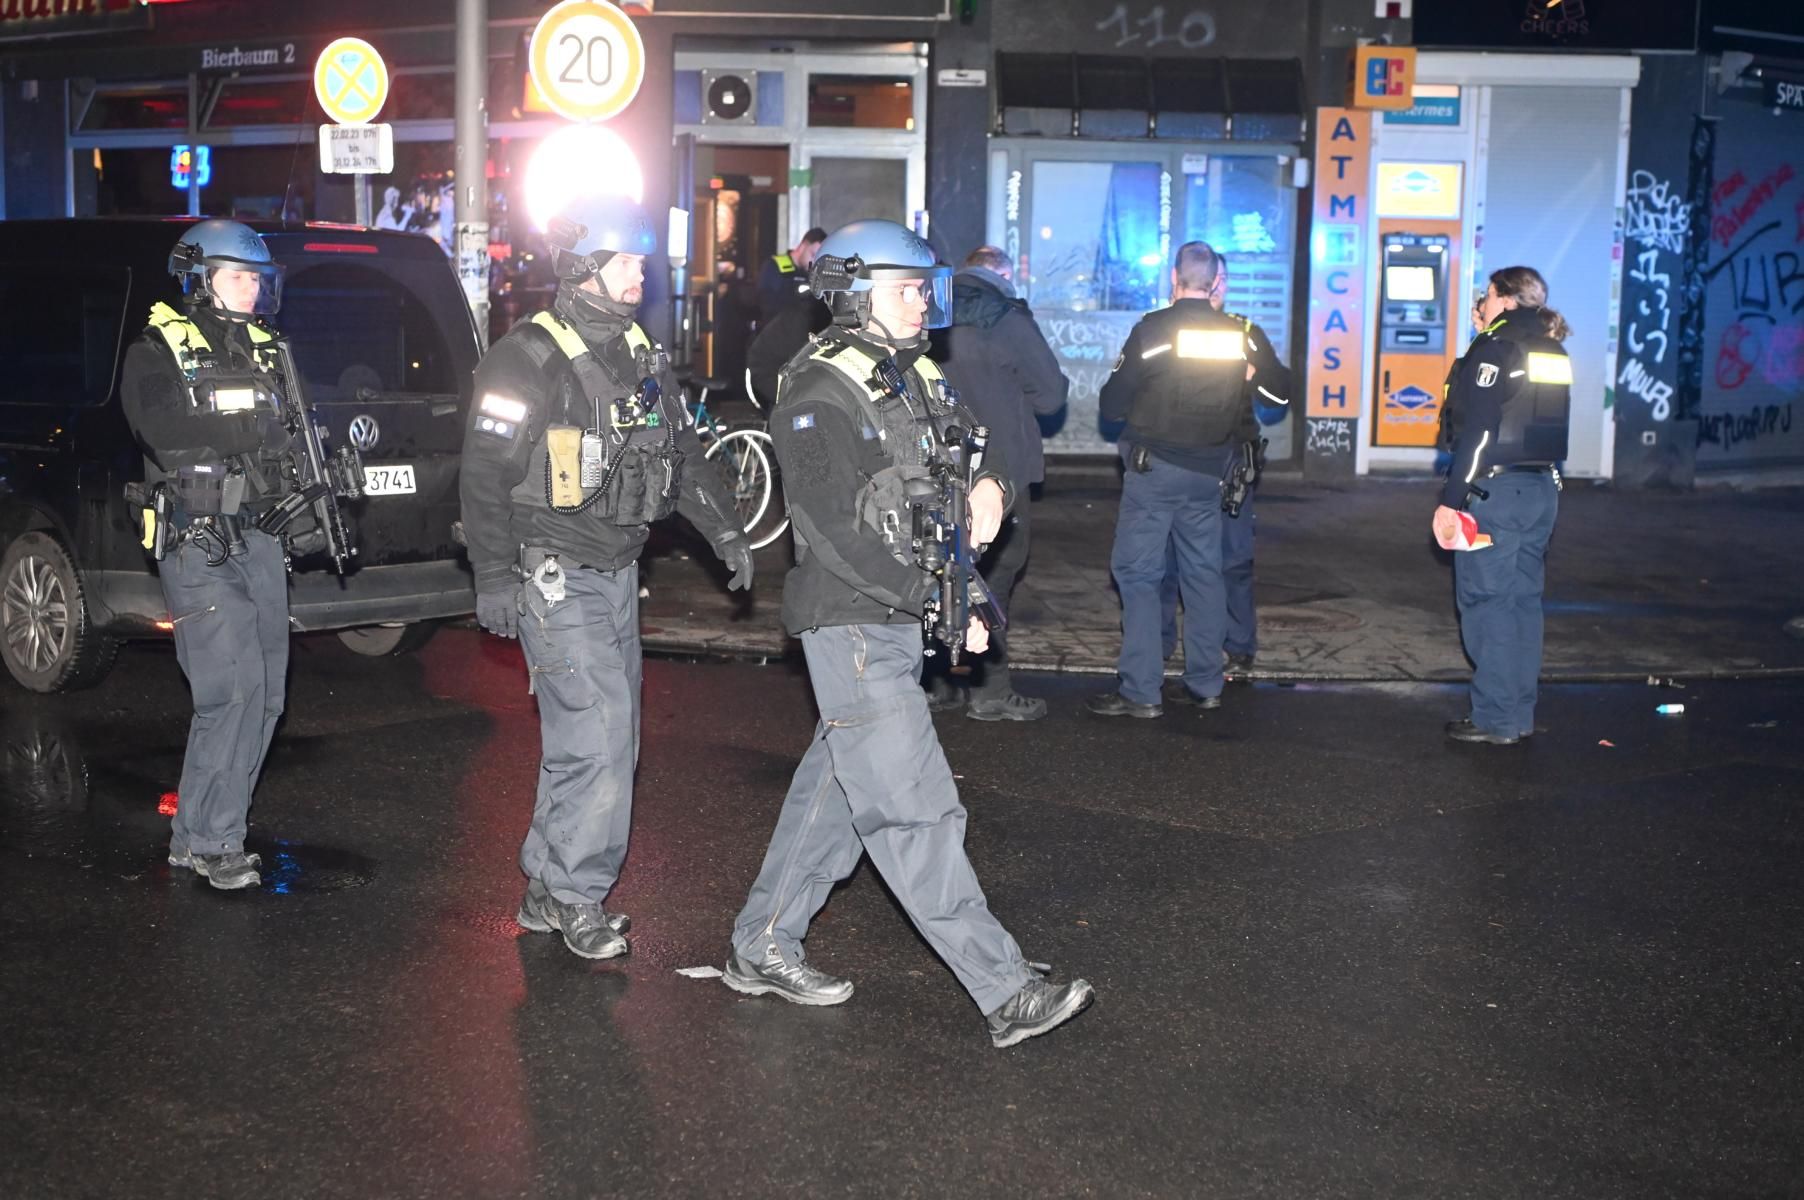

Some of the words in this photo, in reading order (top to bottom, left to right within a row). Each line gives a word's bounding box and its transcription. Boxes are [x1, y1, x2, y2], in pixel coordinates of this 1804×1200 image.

[1096, 5, 1217, 49] 110
[1520, 20, 1591, 34] CHEERS
[202, 46, 279, 68] Bierbaum
[284, 43, 296, 64] 2
[559, 33, 612, 87] 20
[1330, 116, 1357, 218] ATM
[1322, 271, 1349, 408] CASH
[646, 411, 660, 428] 32
[369, 470, 413, 491] 3741
